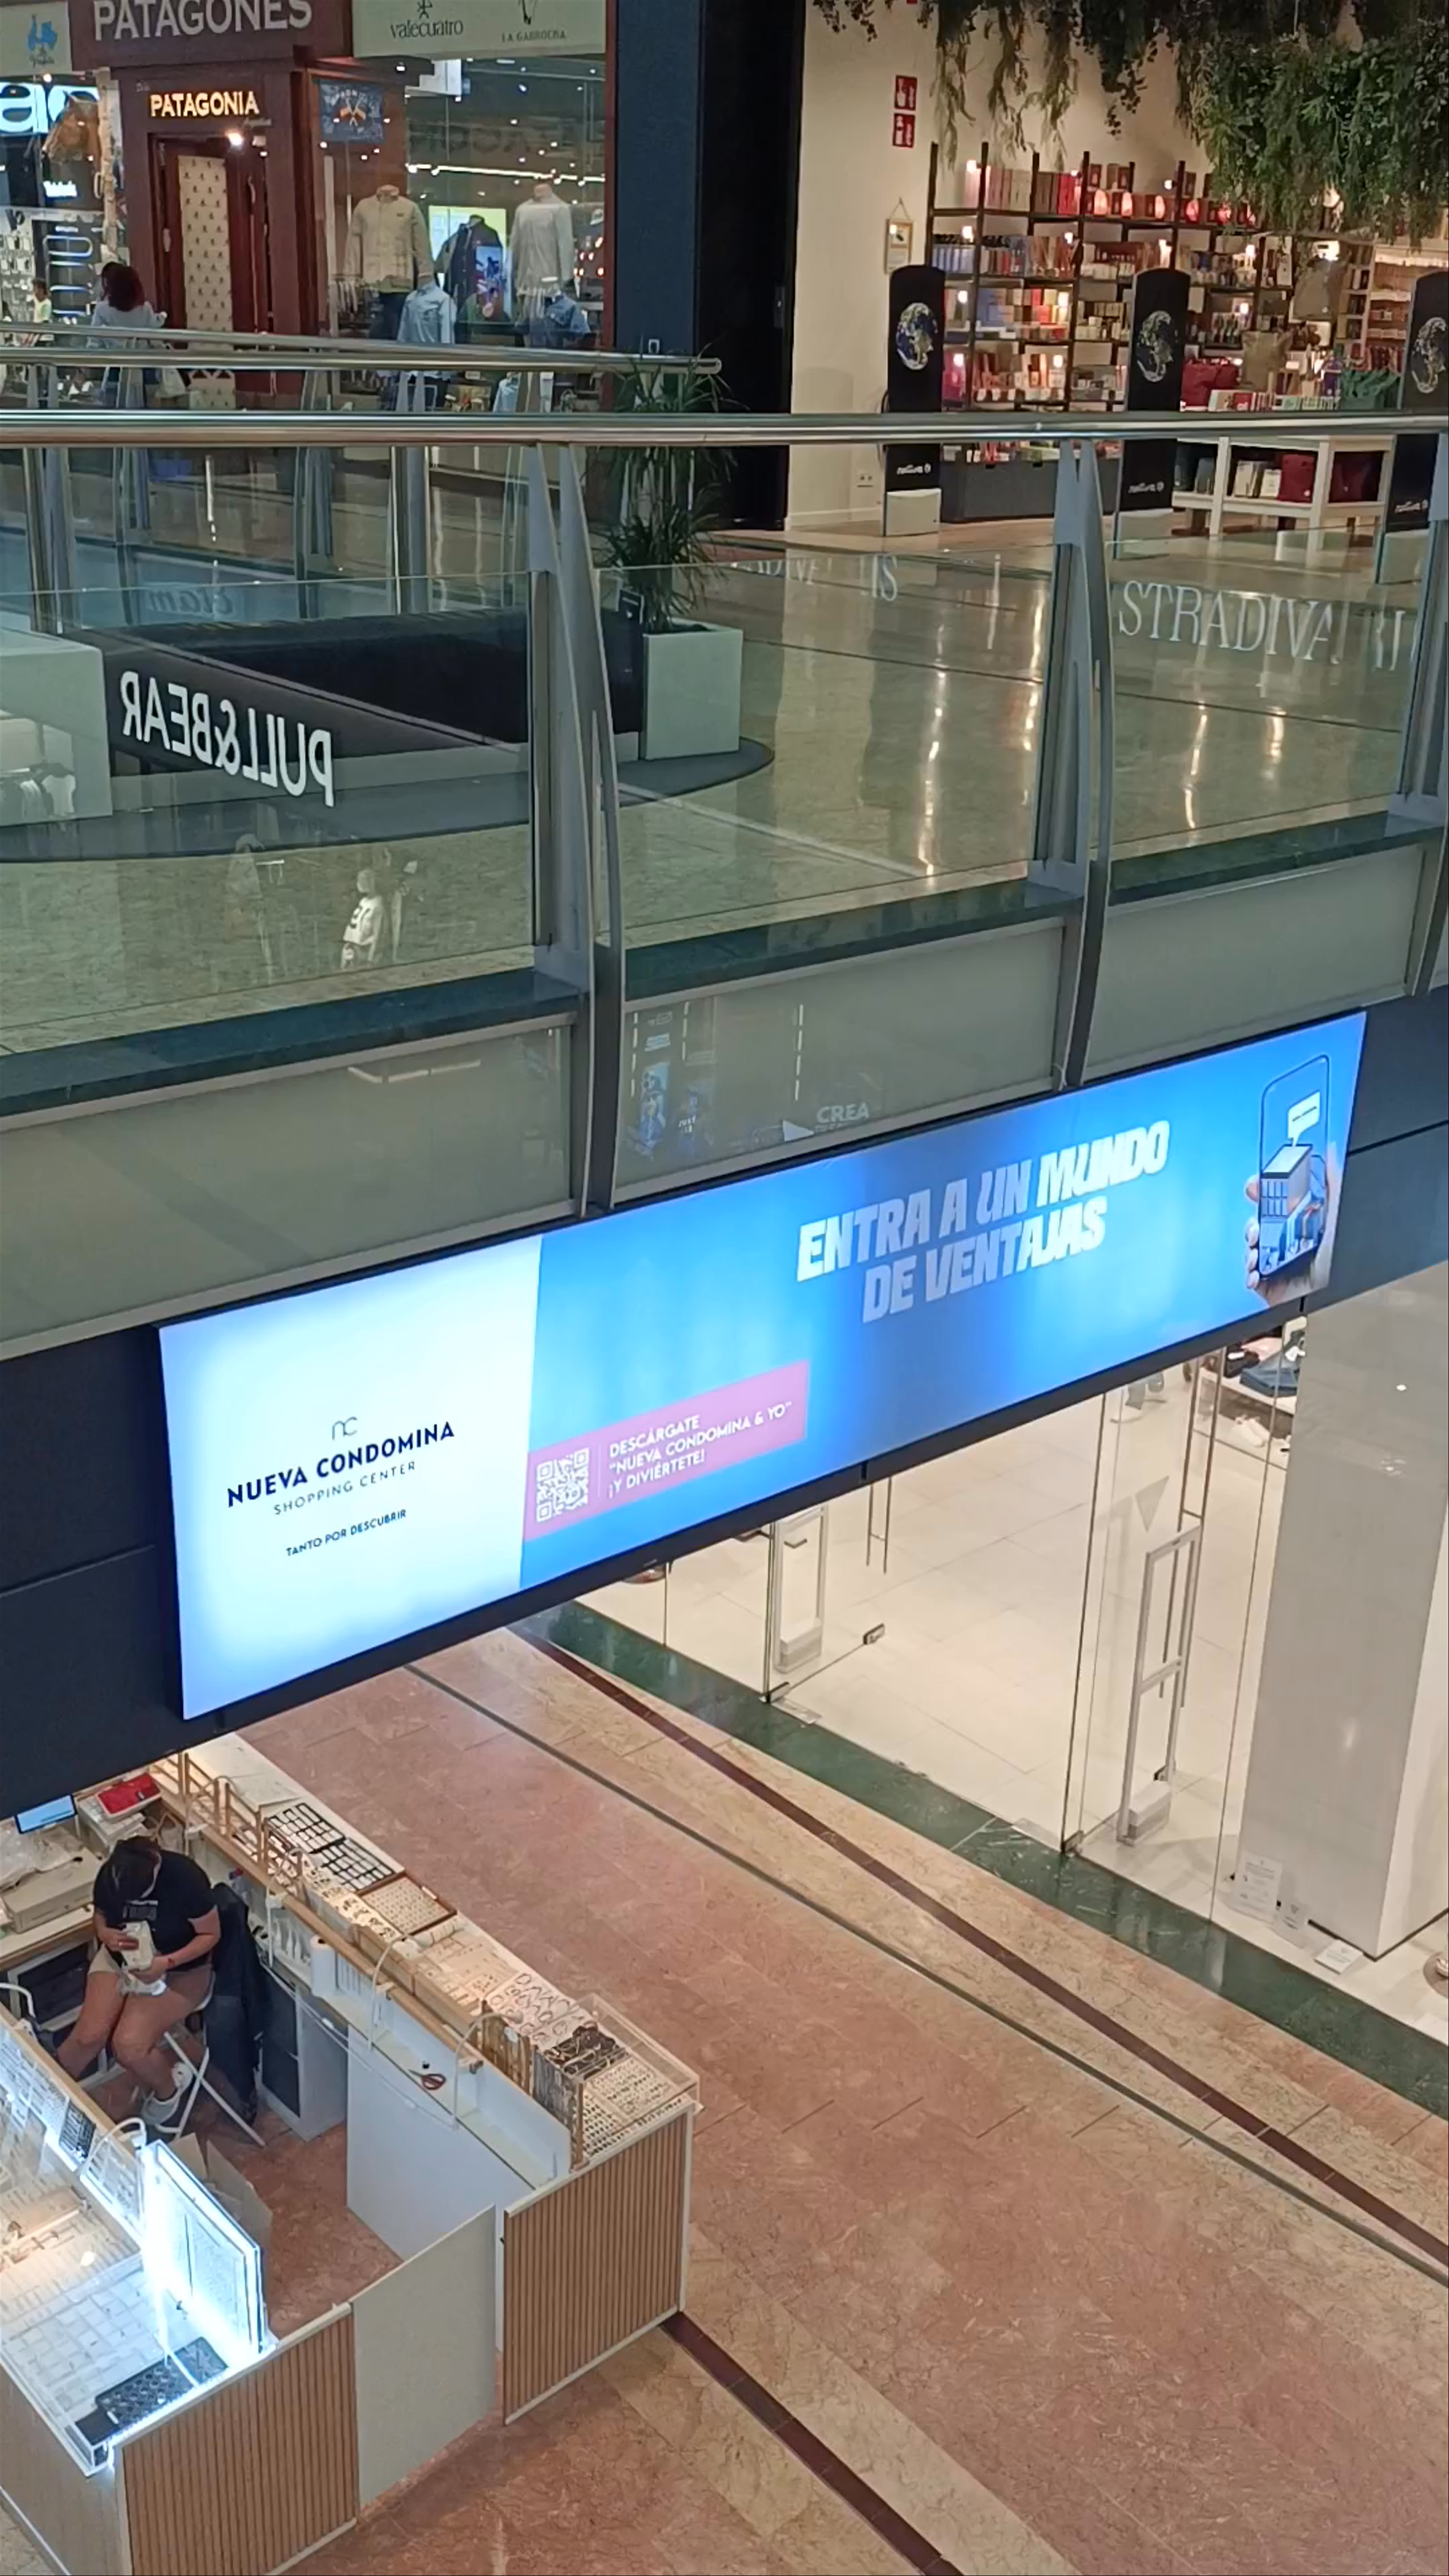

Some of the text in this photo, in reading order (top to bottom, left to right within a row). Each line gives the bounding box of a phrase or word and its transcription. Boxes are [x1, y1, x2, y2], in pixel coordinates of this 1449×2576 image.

[94, 0, 312, 40] PATAGONES
[390, 19, 464, 38] valecuatro
[151, 91, 260, 117] PATAGONIA
[816, 1102, 869, 1123] CREA
[797, 1120, 1170, 1281] ENTRA A UN MUNDO
[862, 1196, 1108, 1323] DE VENTAJAS
[609, 1414, 700, 1458] DESCÁRGATE
[665, 1416, 751, 1456] CONDOMINA
[754, 1411, 764, 1425] &
[227, 1421, 455, 1508] NUEVA CONDOMINA
[609, 1448, 705, 1499] ¡Y DIVIÉRTETE!
[274, 1461, 415, 1515] SHOPPING CENTER
[286, 1509, 406, 1556] TANTO POR DESCUBRIR
